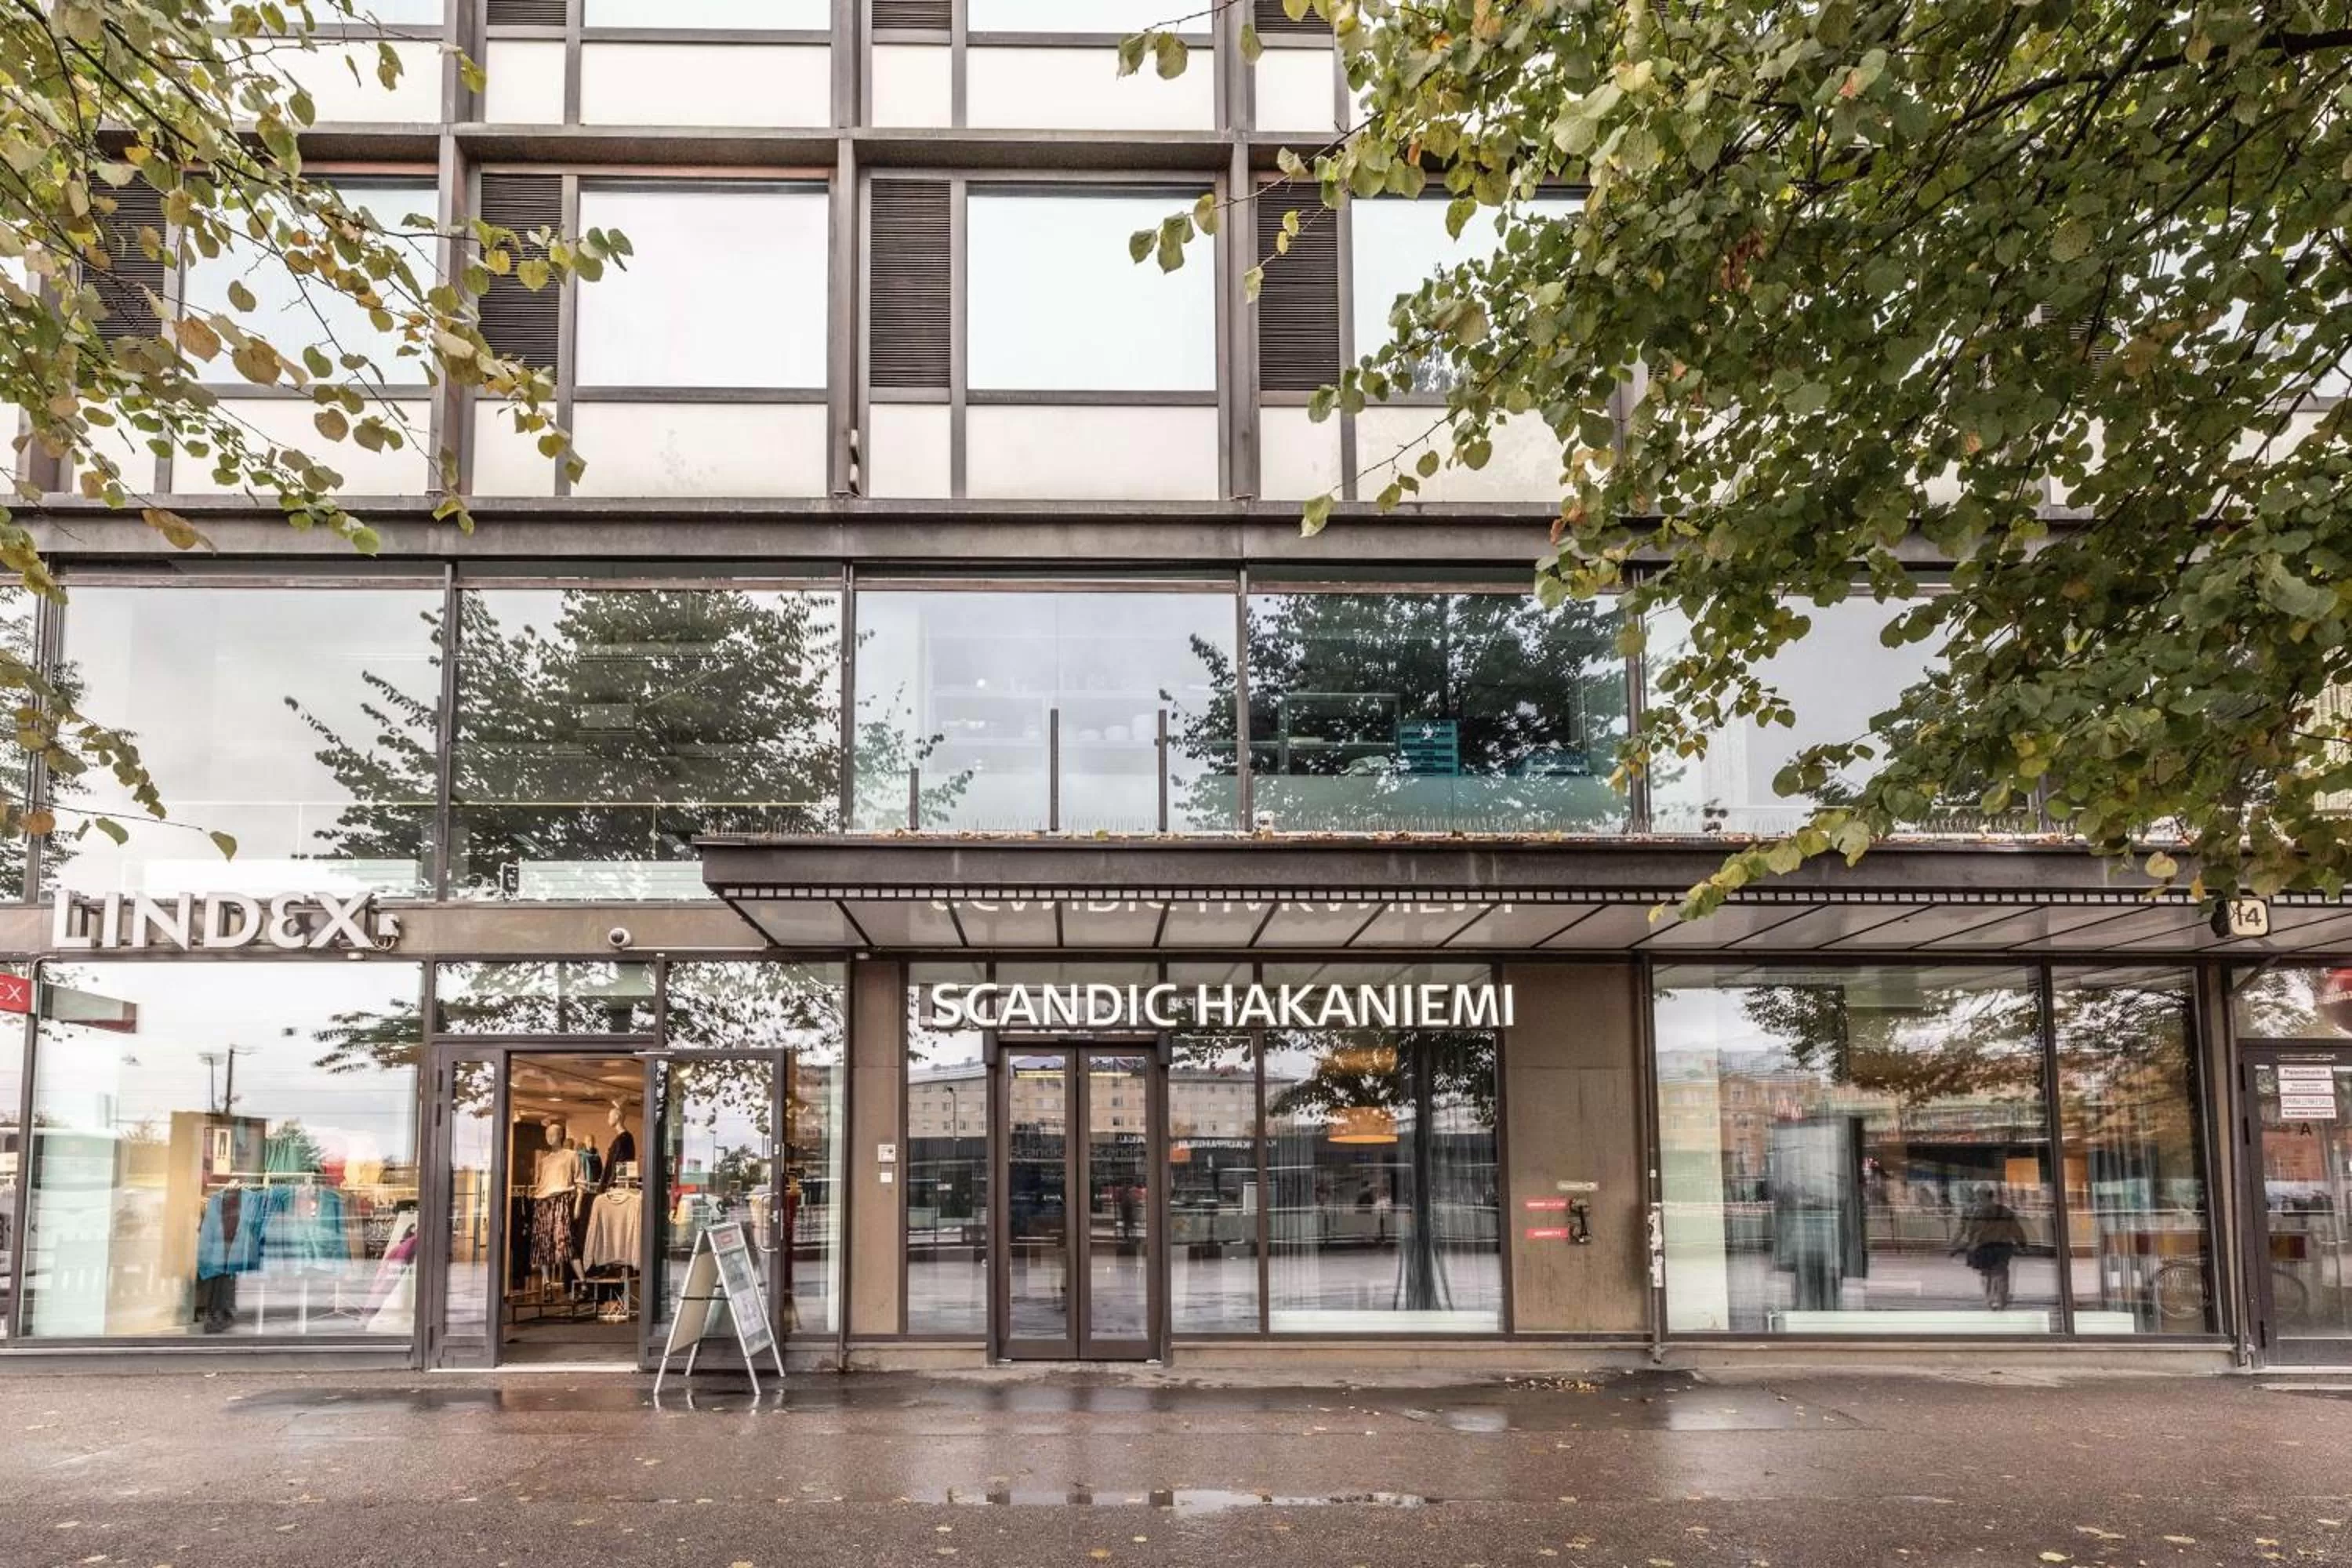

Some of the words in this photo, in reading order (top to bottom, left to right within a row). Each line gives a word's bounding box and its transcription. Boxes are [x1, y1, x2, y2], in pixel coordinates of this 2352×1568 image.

[53, 891, 375, 950] LINDEX
[2236, 907, 2262, 927] 14
[931, 983, 1177, 1027] SCANDIC
[1197, 983, 1514, 1026] HAKANIEMI
[2299, 1122, 2312, 1136] A
